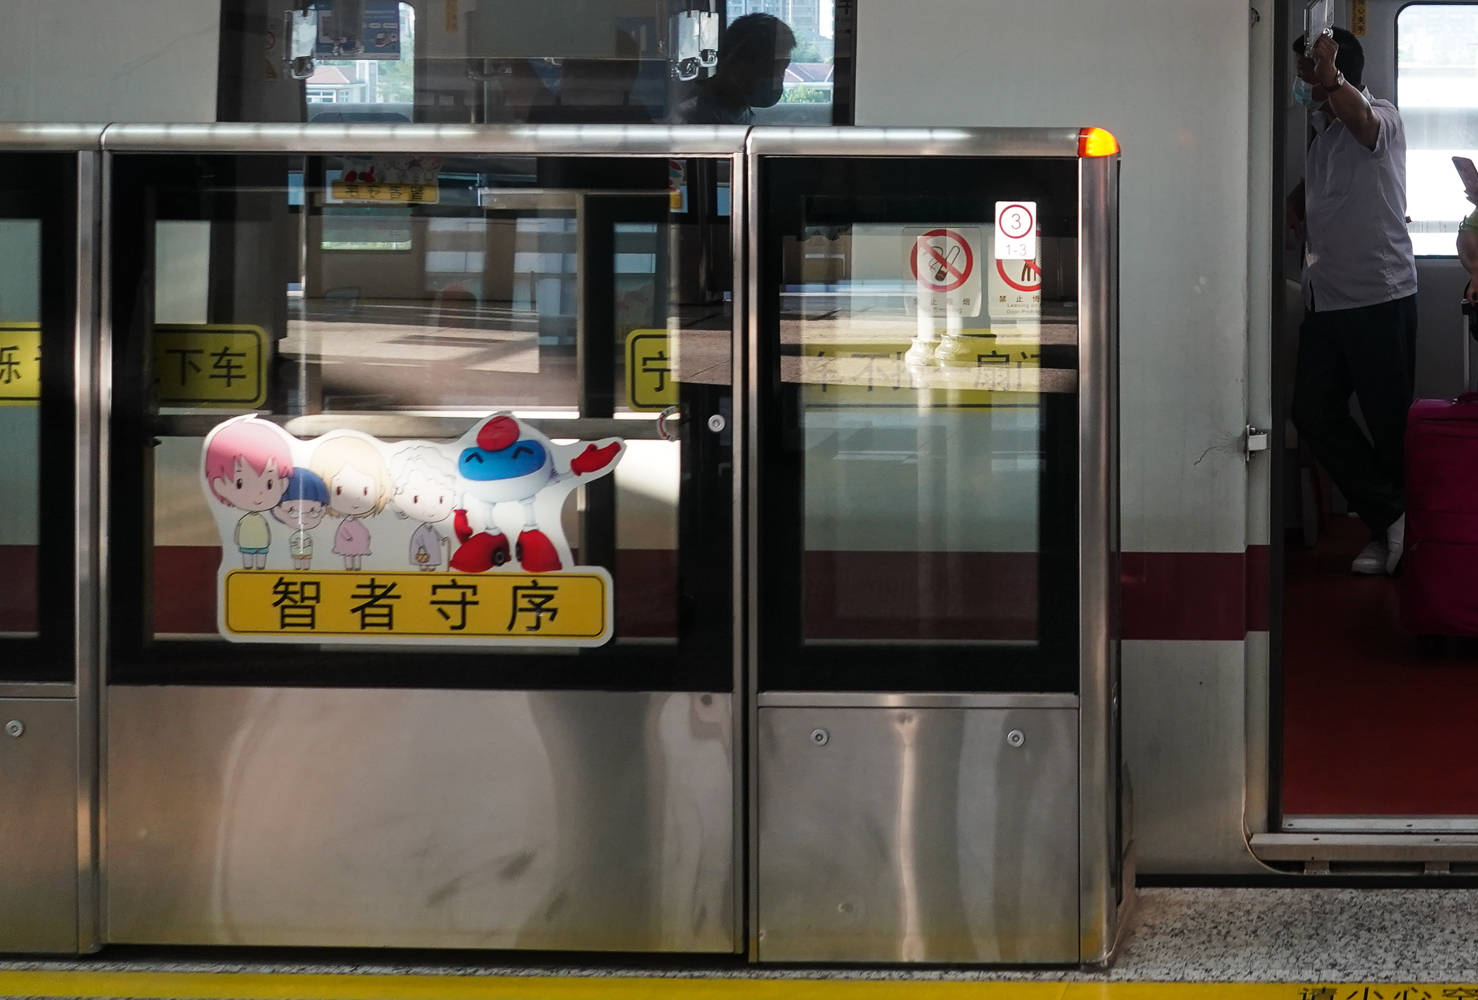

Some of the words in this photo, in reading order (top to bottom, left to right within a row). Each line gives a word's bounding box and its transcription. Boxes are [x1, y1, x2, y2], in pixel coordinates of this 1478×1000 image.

[1010, 213, 1022, 230] 3
[1006, 244, 1027, 257] 1-3
[272, 577, 560, 632] 智者守序
